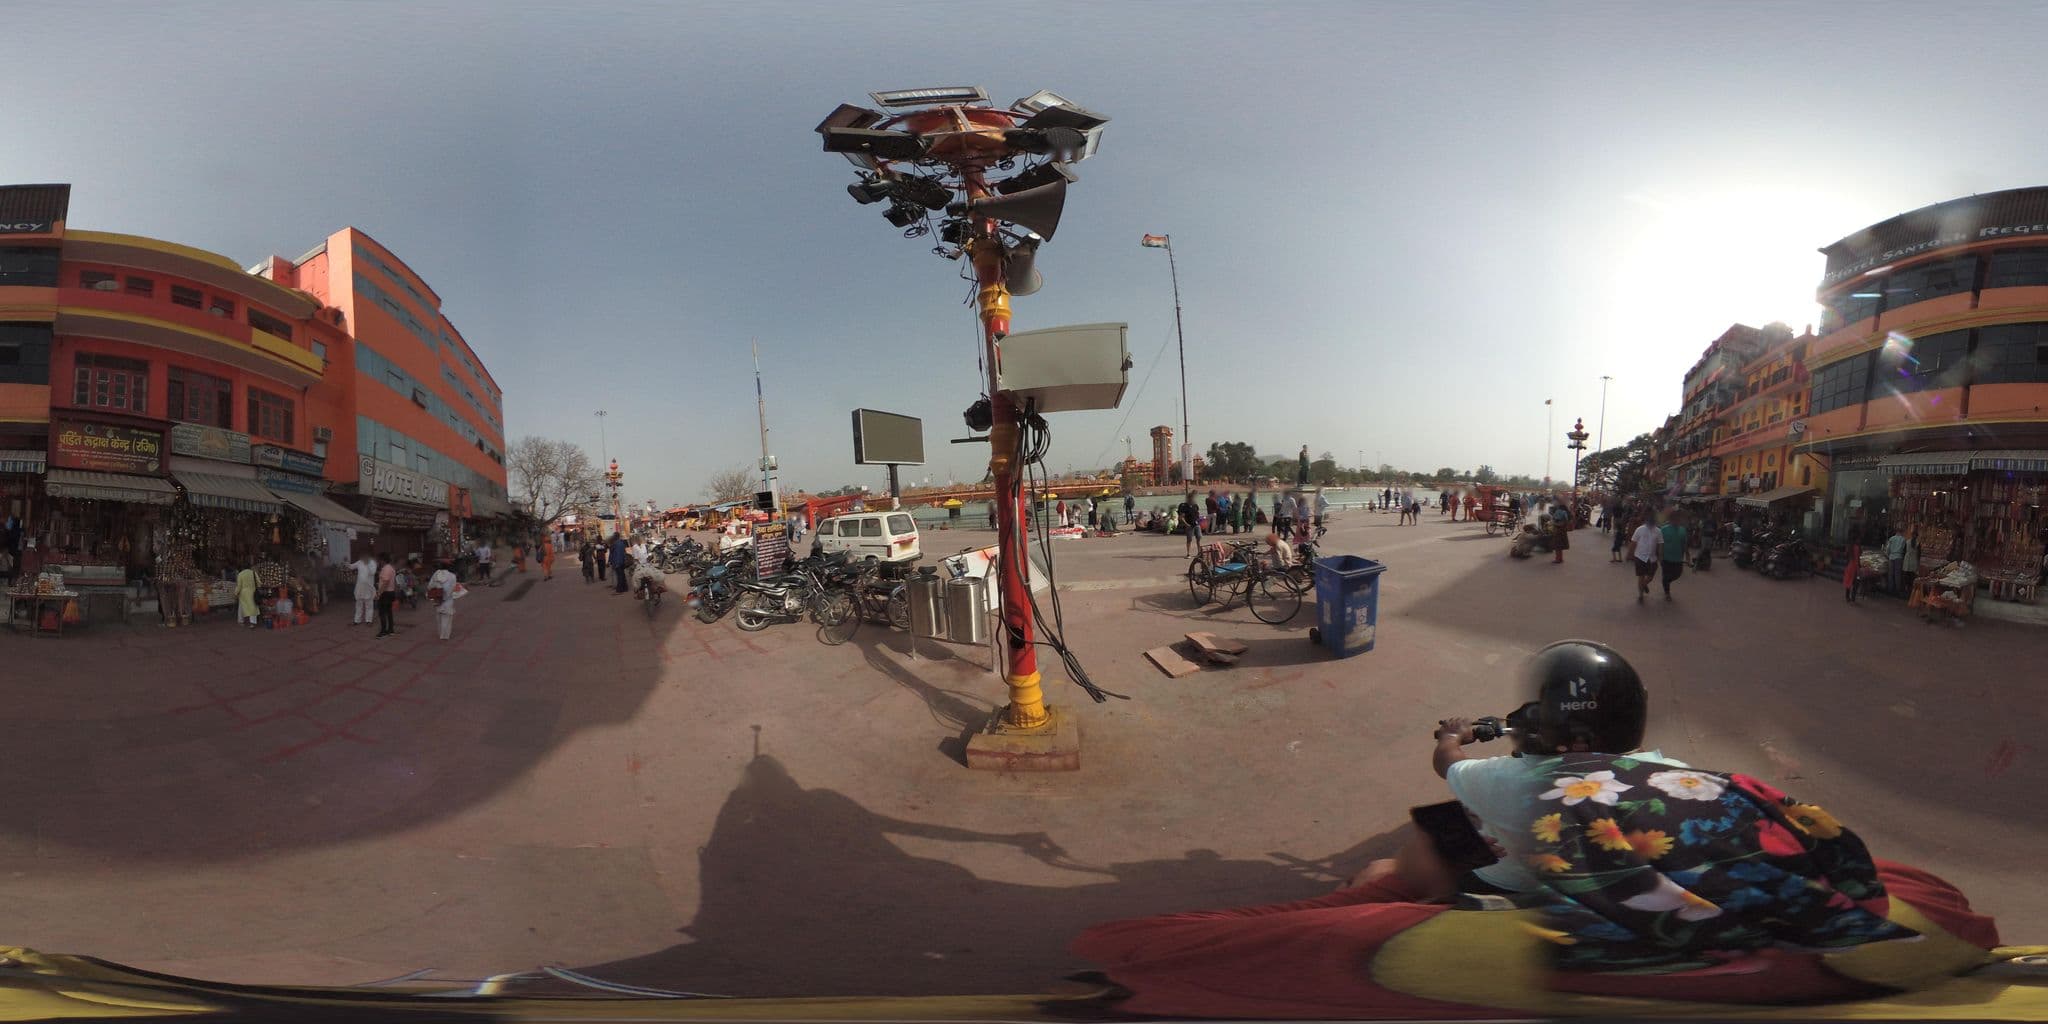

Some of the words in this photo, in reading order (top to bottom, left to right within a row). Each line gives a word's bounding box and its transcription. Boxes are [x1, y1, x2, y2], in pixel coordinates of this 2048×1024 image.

[1881, 232, 1967, 260] SANTOH
[1979, 224, 2048, 237] REGE
[373, 468, 417, 498] HOTEL
